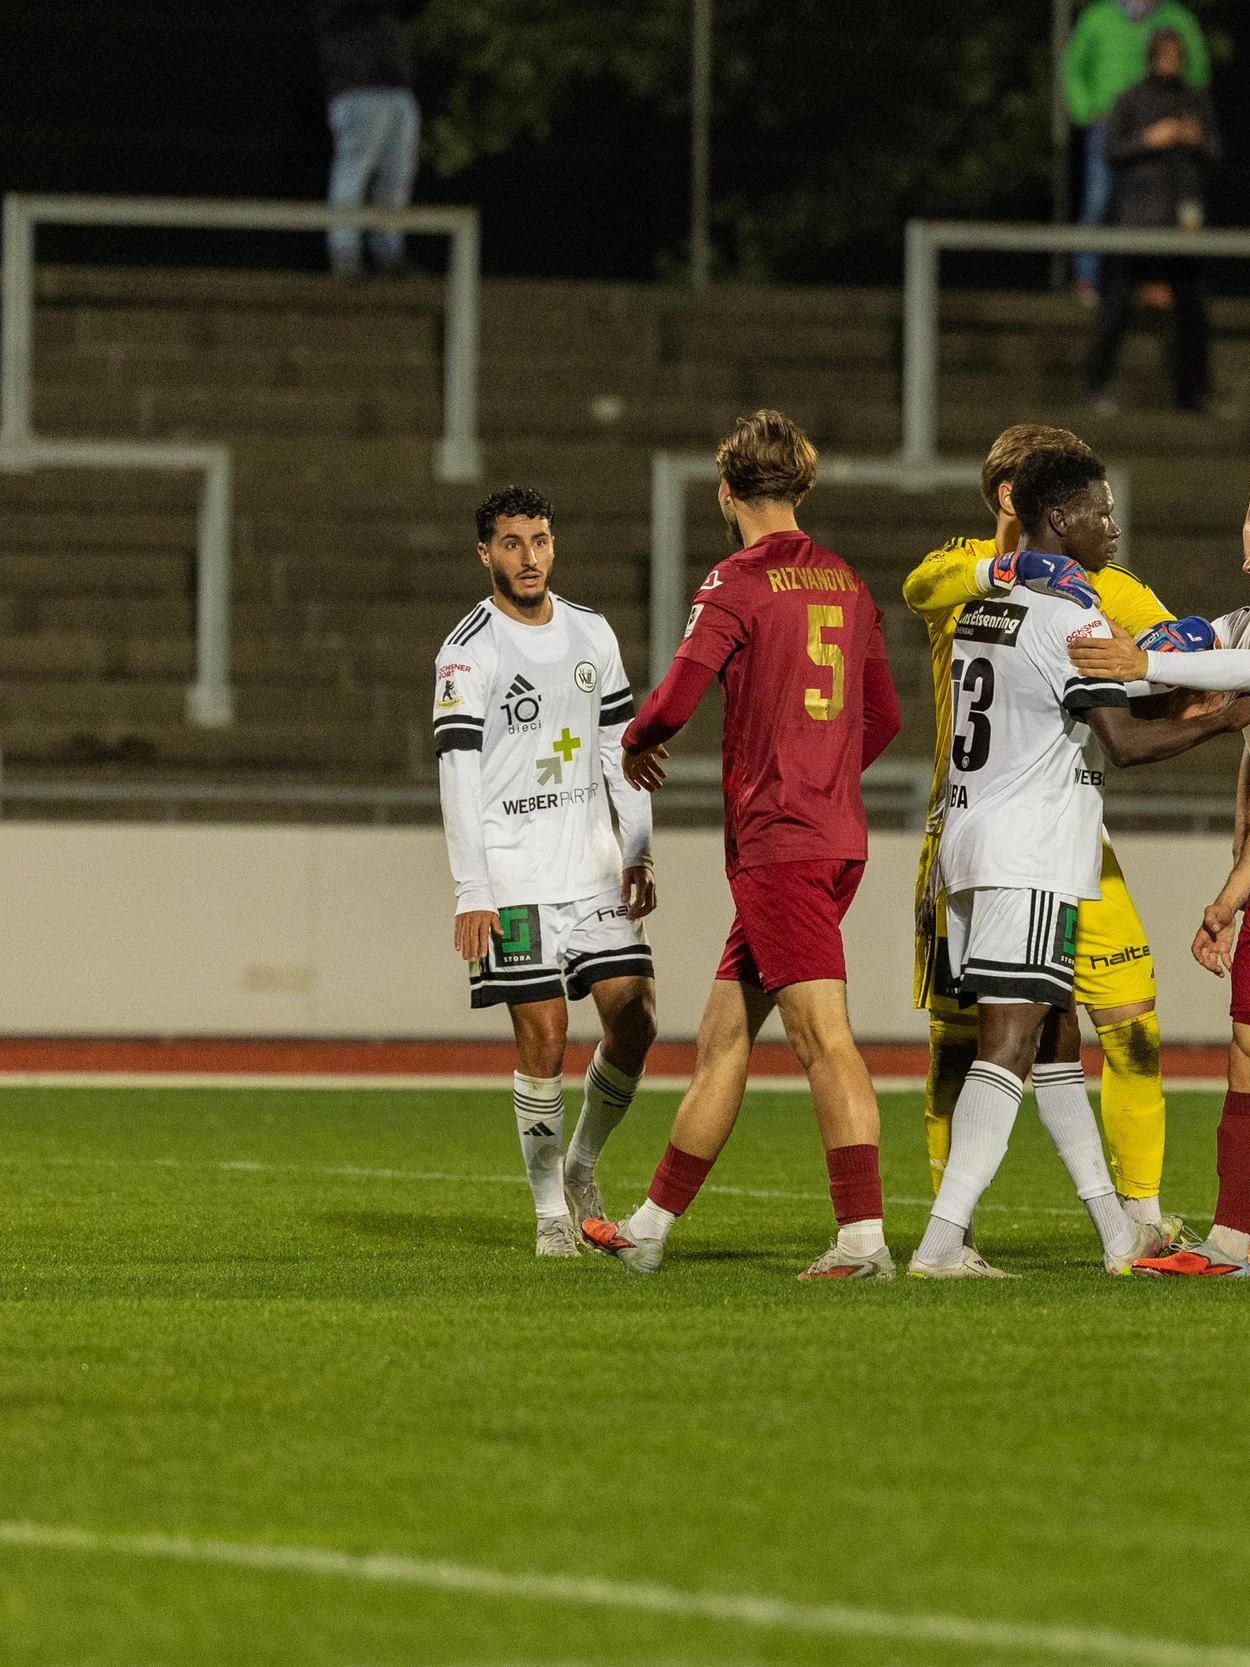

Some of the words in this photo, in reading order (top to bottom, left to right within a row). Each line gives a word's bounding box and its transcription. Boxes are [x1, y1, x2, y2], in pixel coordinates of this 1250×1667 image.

[1066, 620, 1103, 643] OCHSNER
[804, 604, 844, 721] 5
[507, 720, 542, 734] dieci
[503, 955, 531, 963] STORA
